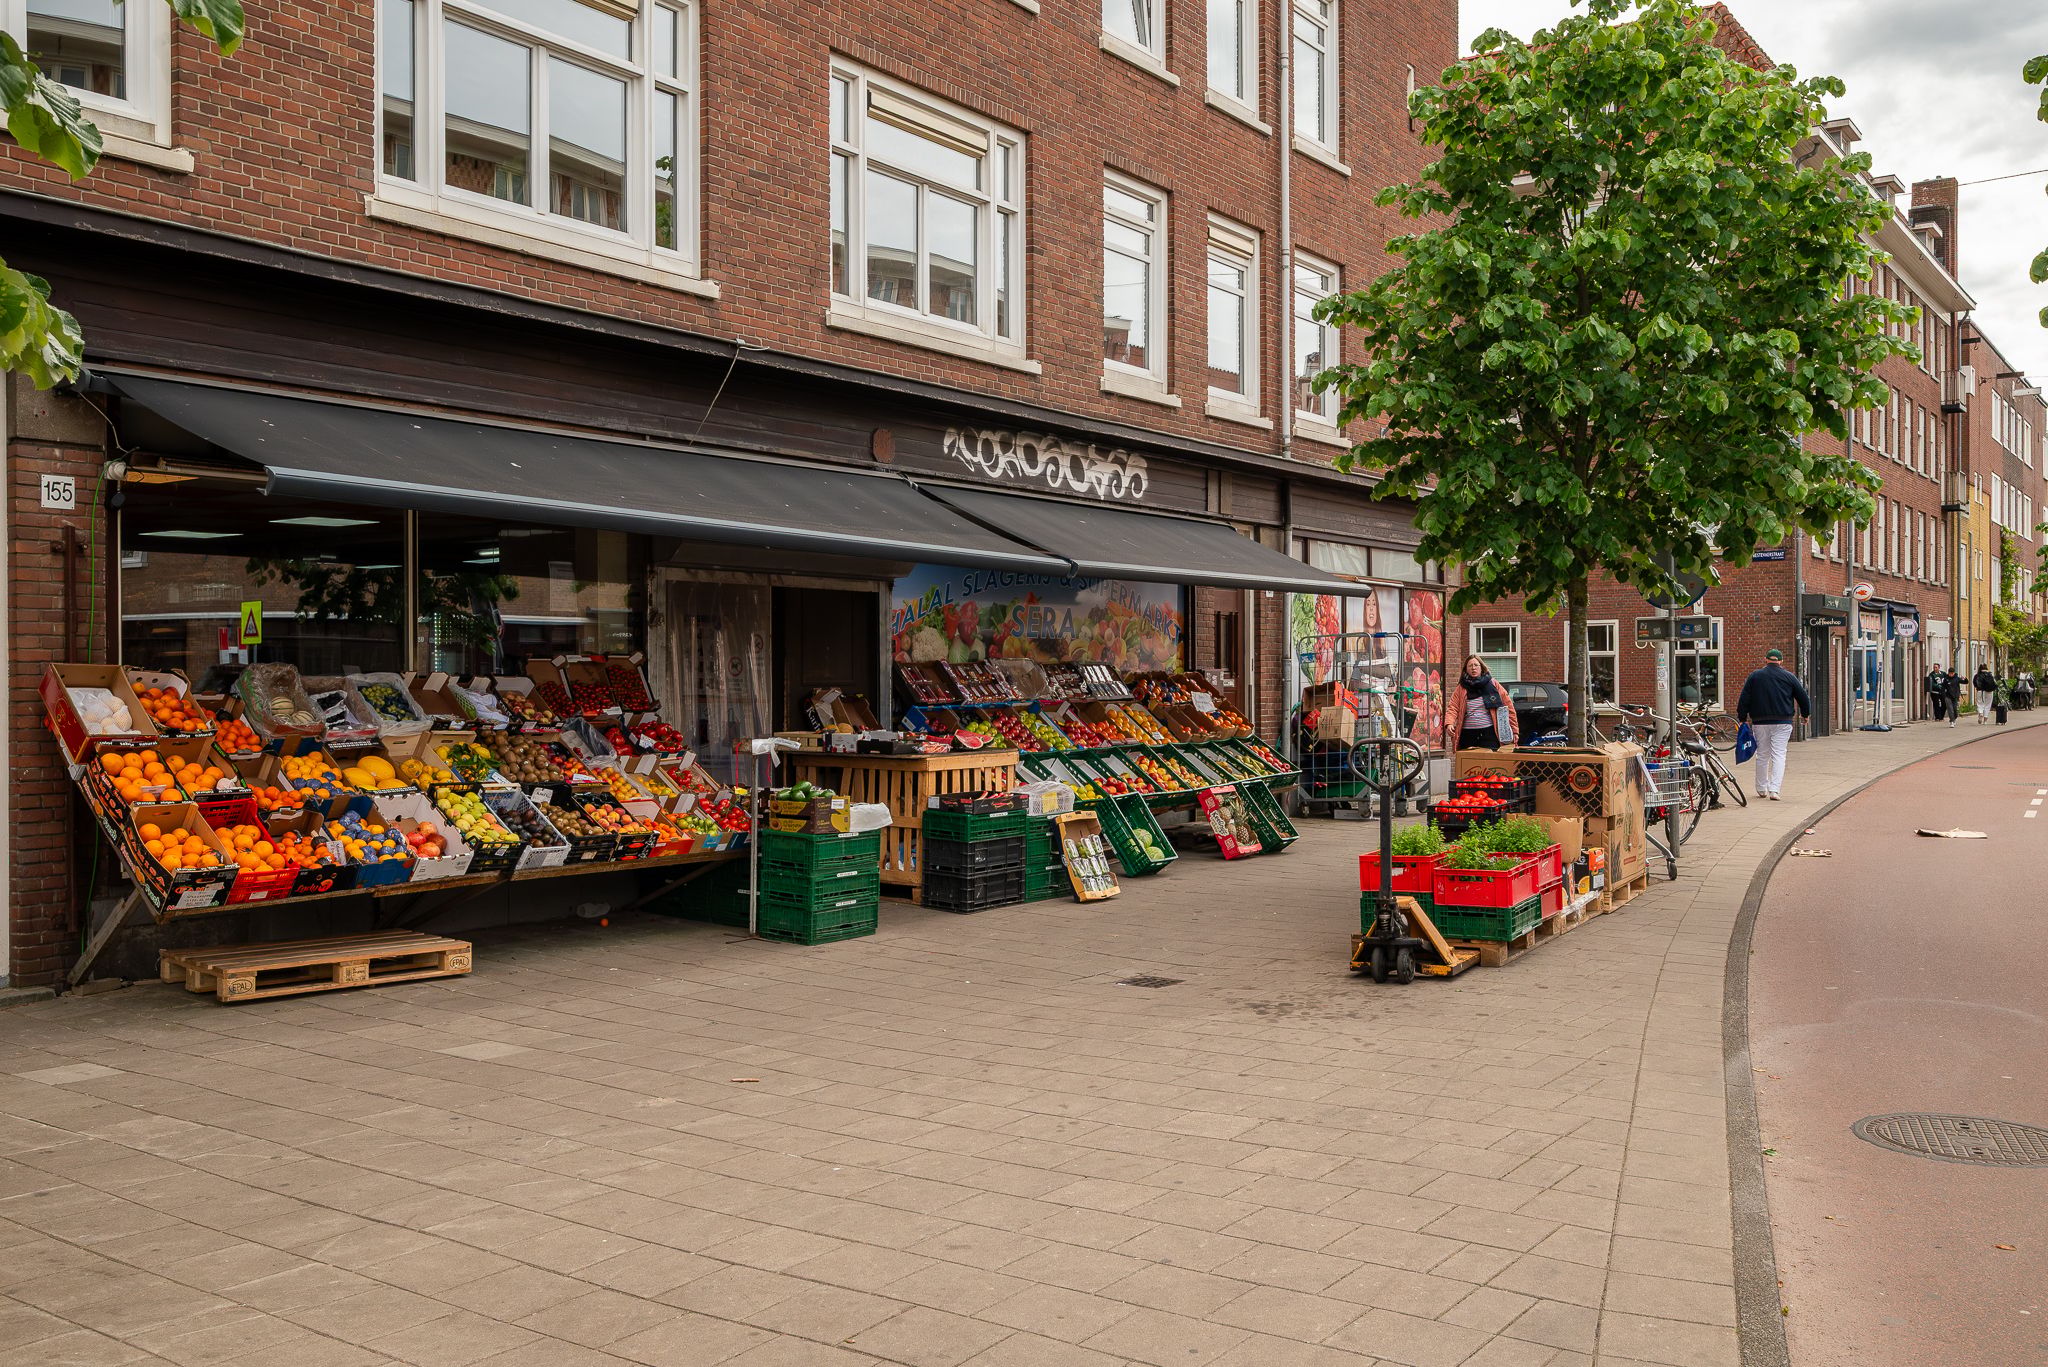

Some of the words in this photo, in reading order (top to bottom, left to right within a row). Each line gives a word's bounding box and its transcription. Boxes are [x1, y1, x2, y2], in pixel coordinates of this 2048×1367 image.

[44, 481, 73, 502] 155
[890, 582, 954, 635] HALAL
[962, 571, 1050, 597] SLAGERIJ
[1078, 577, 1183, 645] SUPERMARKT
[1011, 604, 1077, 640] SERA
[1809, 617, 1842, 626] Coffeeshop
